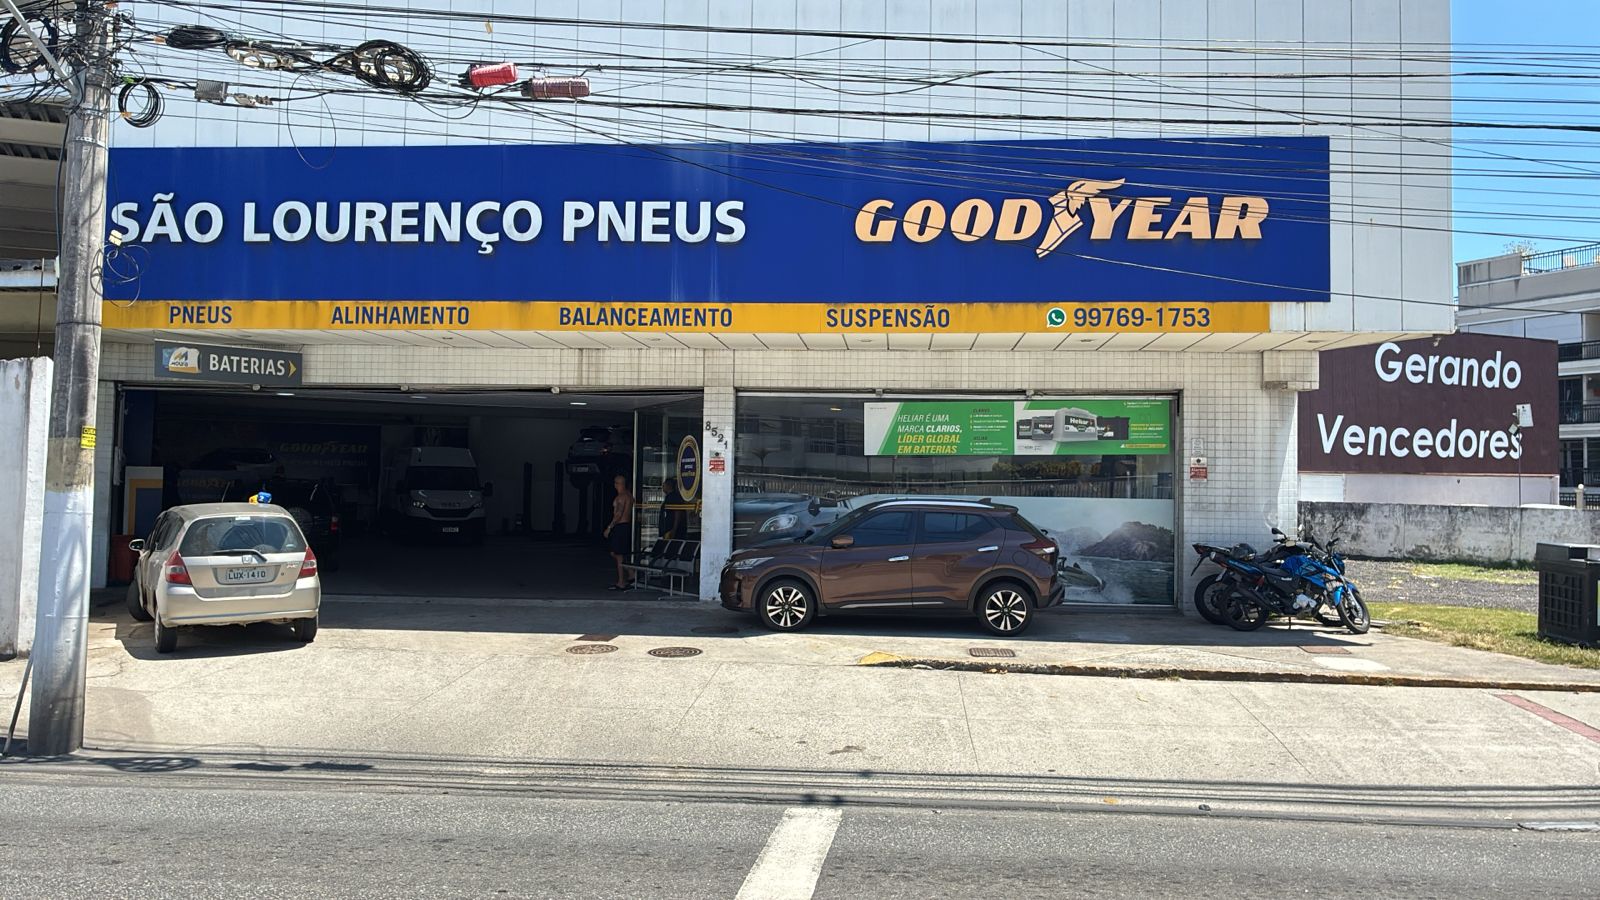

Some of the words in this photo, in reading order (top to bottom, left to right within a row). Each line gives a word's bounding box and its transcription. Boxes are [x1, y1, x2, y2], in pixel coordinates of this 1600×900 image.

[109, 193, 224, 243] SÃO
[243, 200, 542, 254] LOURENÇO
[563, 200, 746, 243] PNEUS
[855, 194, 1269, 244] GOODYEAR
[169, 306, 233, 324] PNEUS
[331, 306, 470, 325] ALINHAMENTO
[558, 307, 733, 327] BALANCEAMENTO
[826, 305, 950, 328] SUSPENSÃO
[1074, 307, 1211, 327] 99769-1753
[209, 353, 286, 376] BATERIAS
[1374, 342, 1522, 390] Gerando
[897, 414, 924, 422] HELIAR
[926, 412, 931, 422] É
[932, 414, 949, 422] UMA
[705, 421, 728, 450] 8521
[897, 424, 924, 433] MARCA
[926, 424, 963, 433] CLARIOS,
[897, 432, 924, 443] LÍDER
[926, 434, 961, 443] GLOBAL
[1317, 412, 1523, 460] Vencedores
[897, 445, 913, 454] EM
[914, 445, 958, 454] BATERIAS
